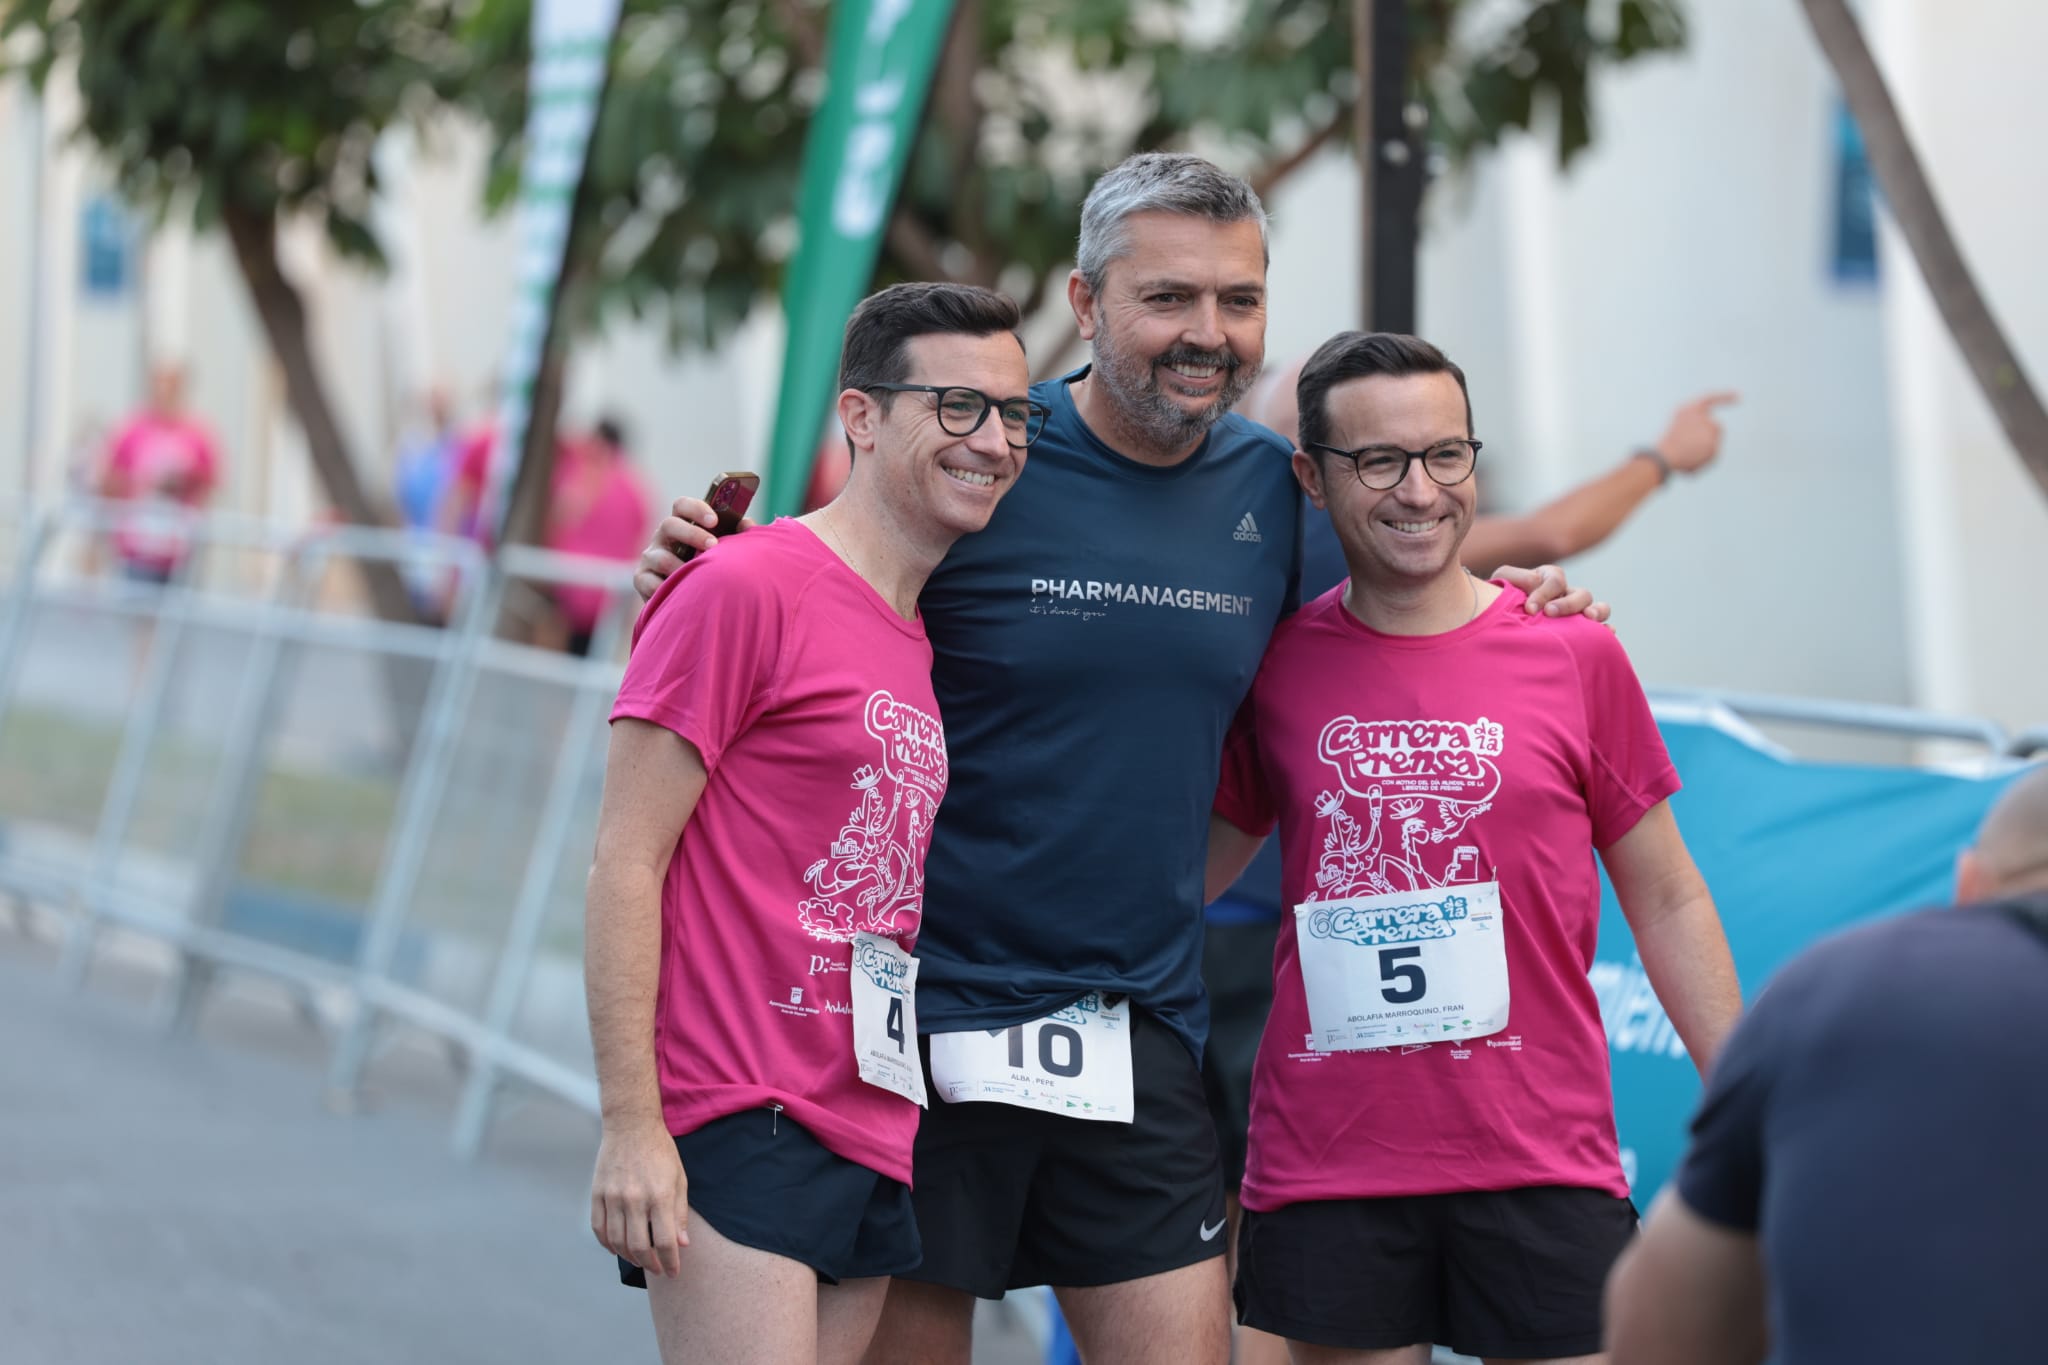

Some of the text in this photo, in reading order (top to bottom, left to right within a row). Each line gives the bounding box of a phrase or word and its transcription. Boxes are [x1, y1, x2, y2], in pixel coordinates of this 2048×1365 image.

[1233, 530, 1262, 543] adidas
[1031, 578, 1253, 617] PHARMANAGEMENT
[1328, 721, 1499, 751] Carrera de
[1477, 736, 1499, 751] la
[1350, 750, 1481, 778] Prensa
[1336, 902, 1442, 934] Carrera
[1354, 920, 1455, 945] Prensa
[1378, 945, 1427, 1005] 5
[886, 996, 905, 1055] 4
[1347, 1013, 1384, 1023] ABOLAFIA
[1442, 1004, 1465, 1012] FRAN
[988, 1022, 1083, 1078] 10
[1011, 1073, 1030, 1082] ALBA
[1036, 1078, 1055, 1087] PEPE
